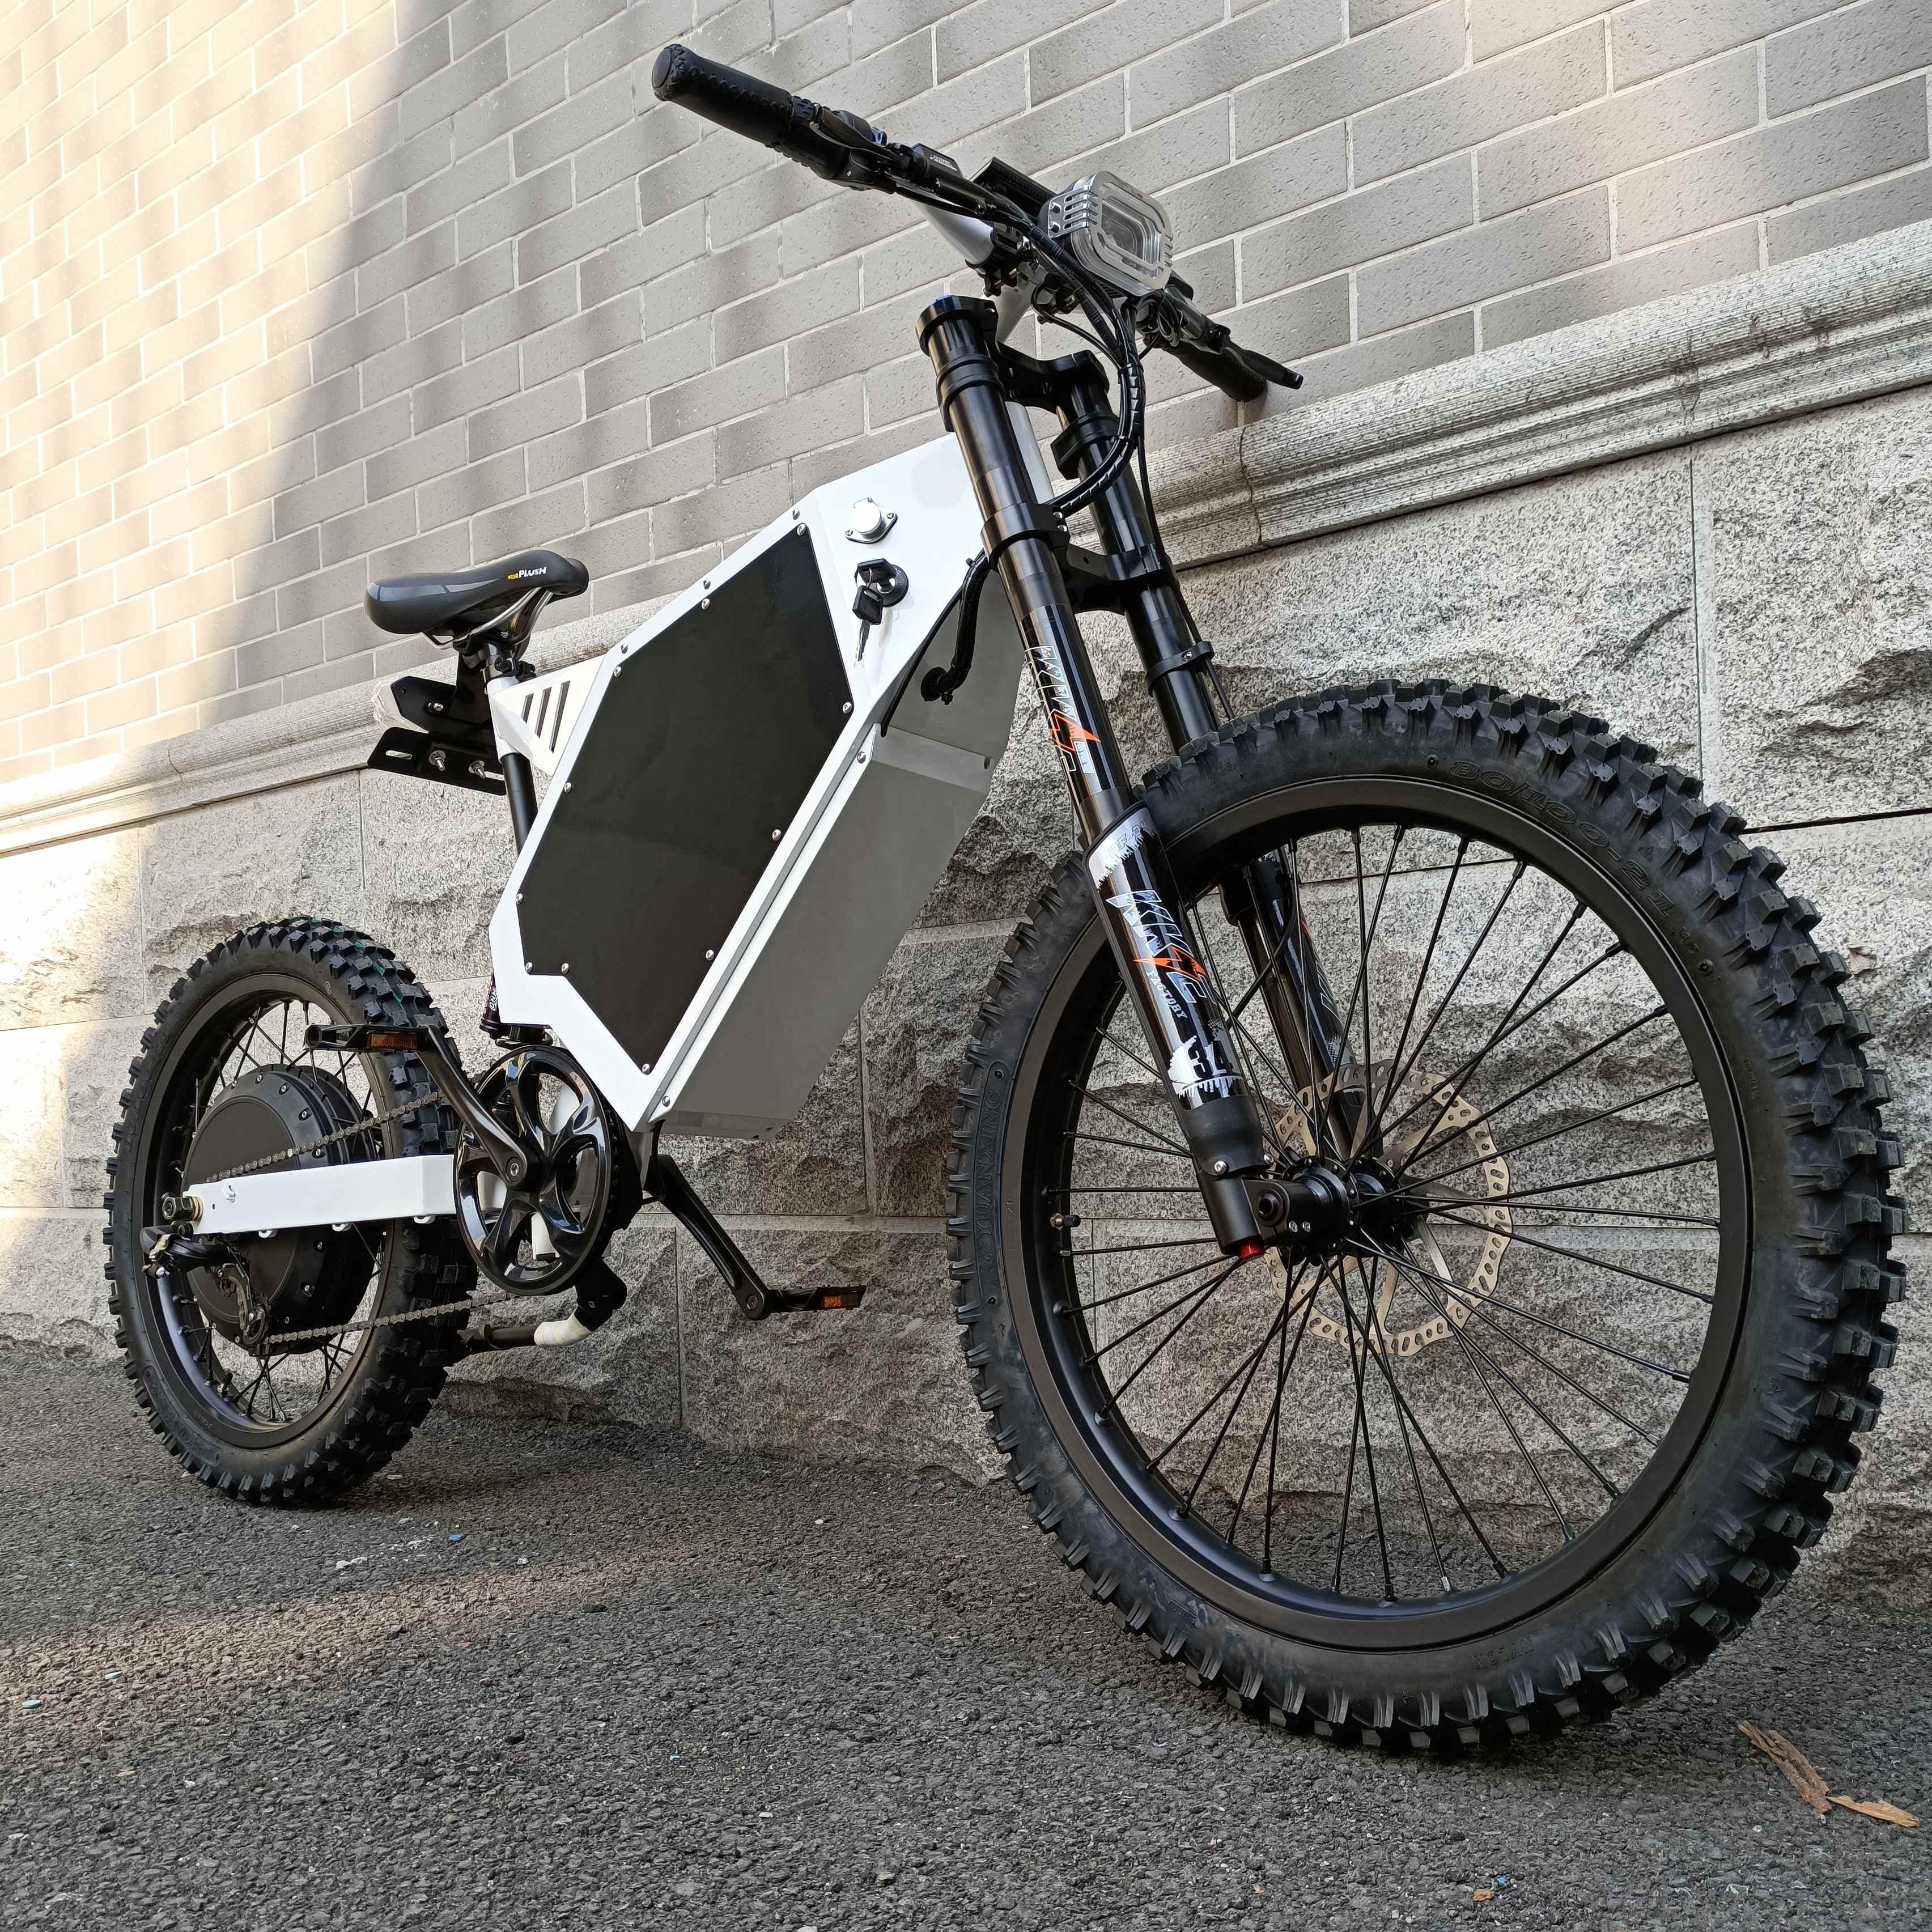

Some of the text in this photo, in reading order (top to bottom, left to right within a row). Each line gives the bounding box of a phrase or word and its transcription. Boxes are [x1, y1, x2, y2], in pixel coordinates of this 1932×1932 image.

[519, 567, 547, 578] PLUSH
[1106, 890, 1217, 1005] KKE
[1188, 1039, 1233, 1079] 34
[975, 1090, 1001, 1235] YUANXING
